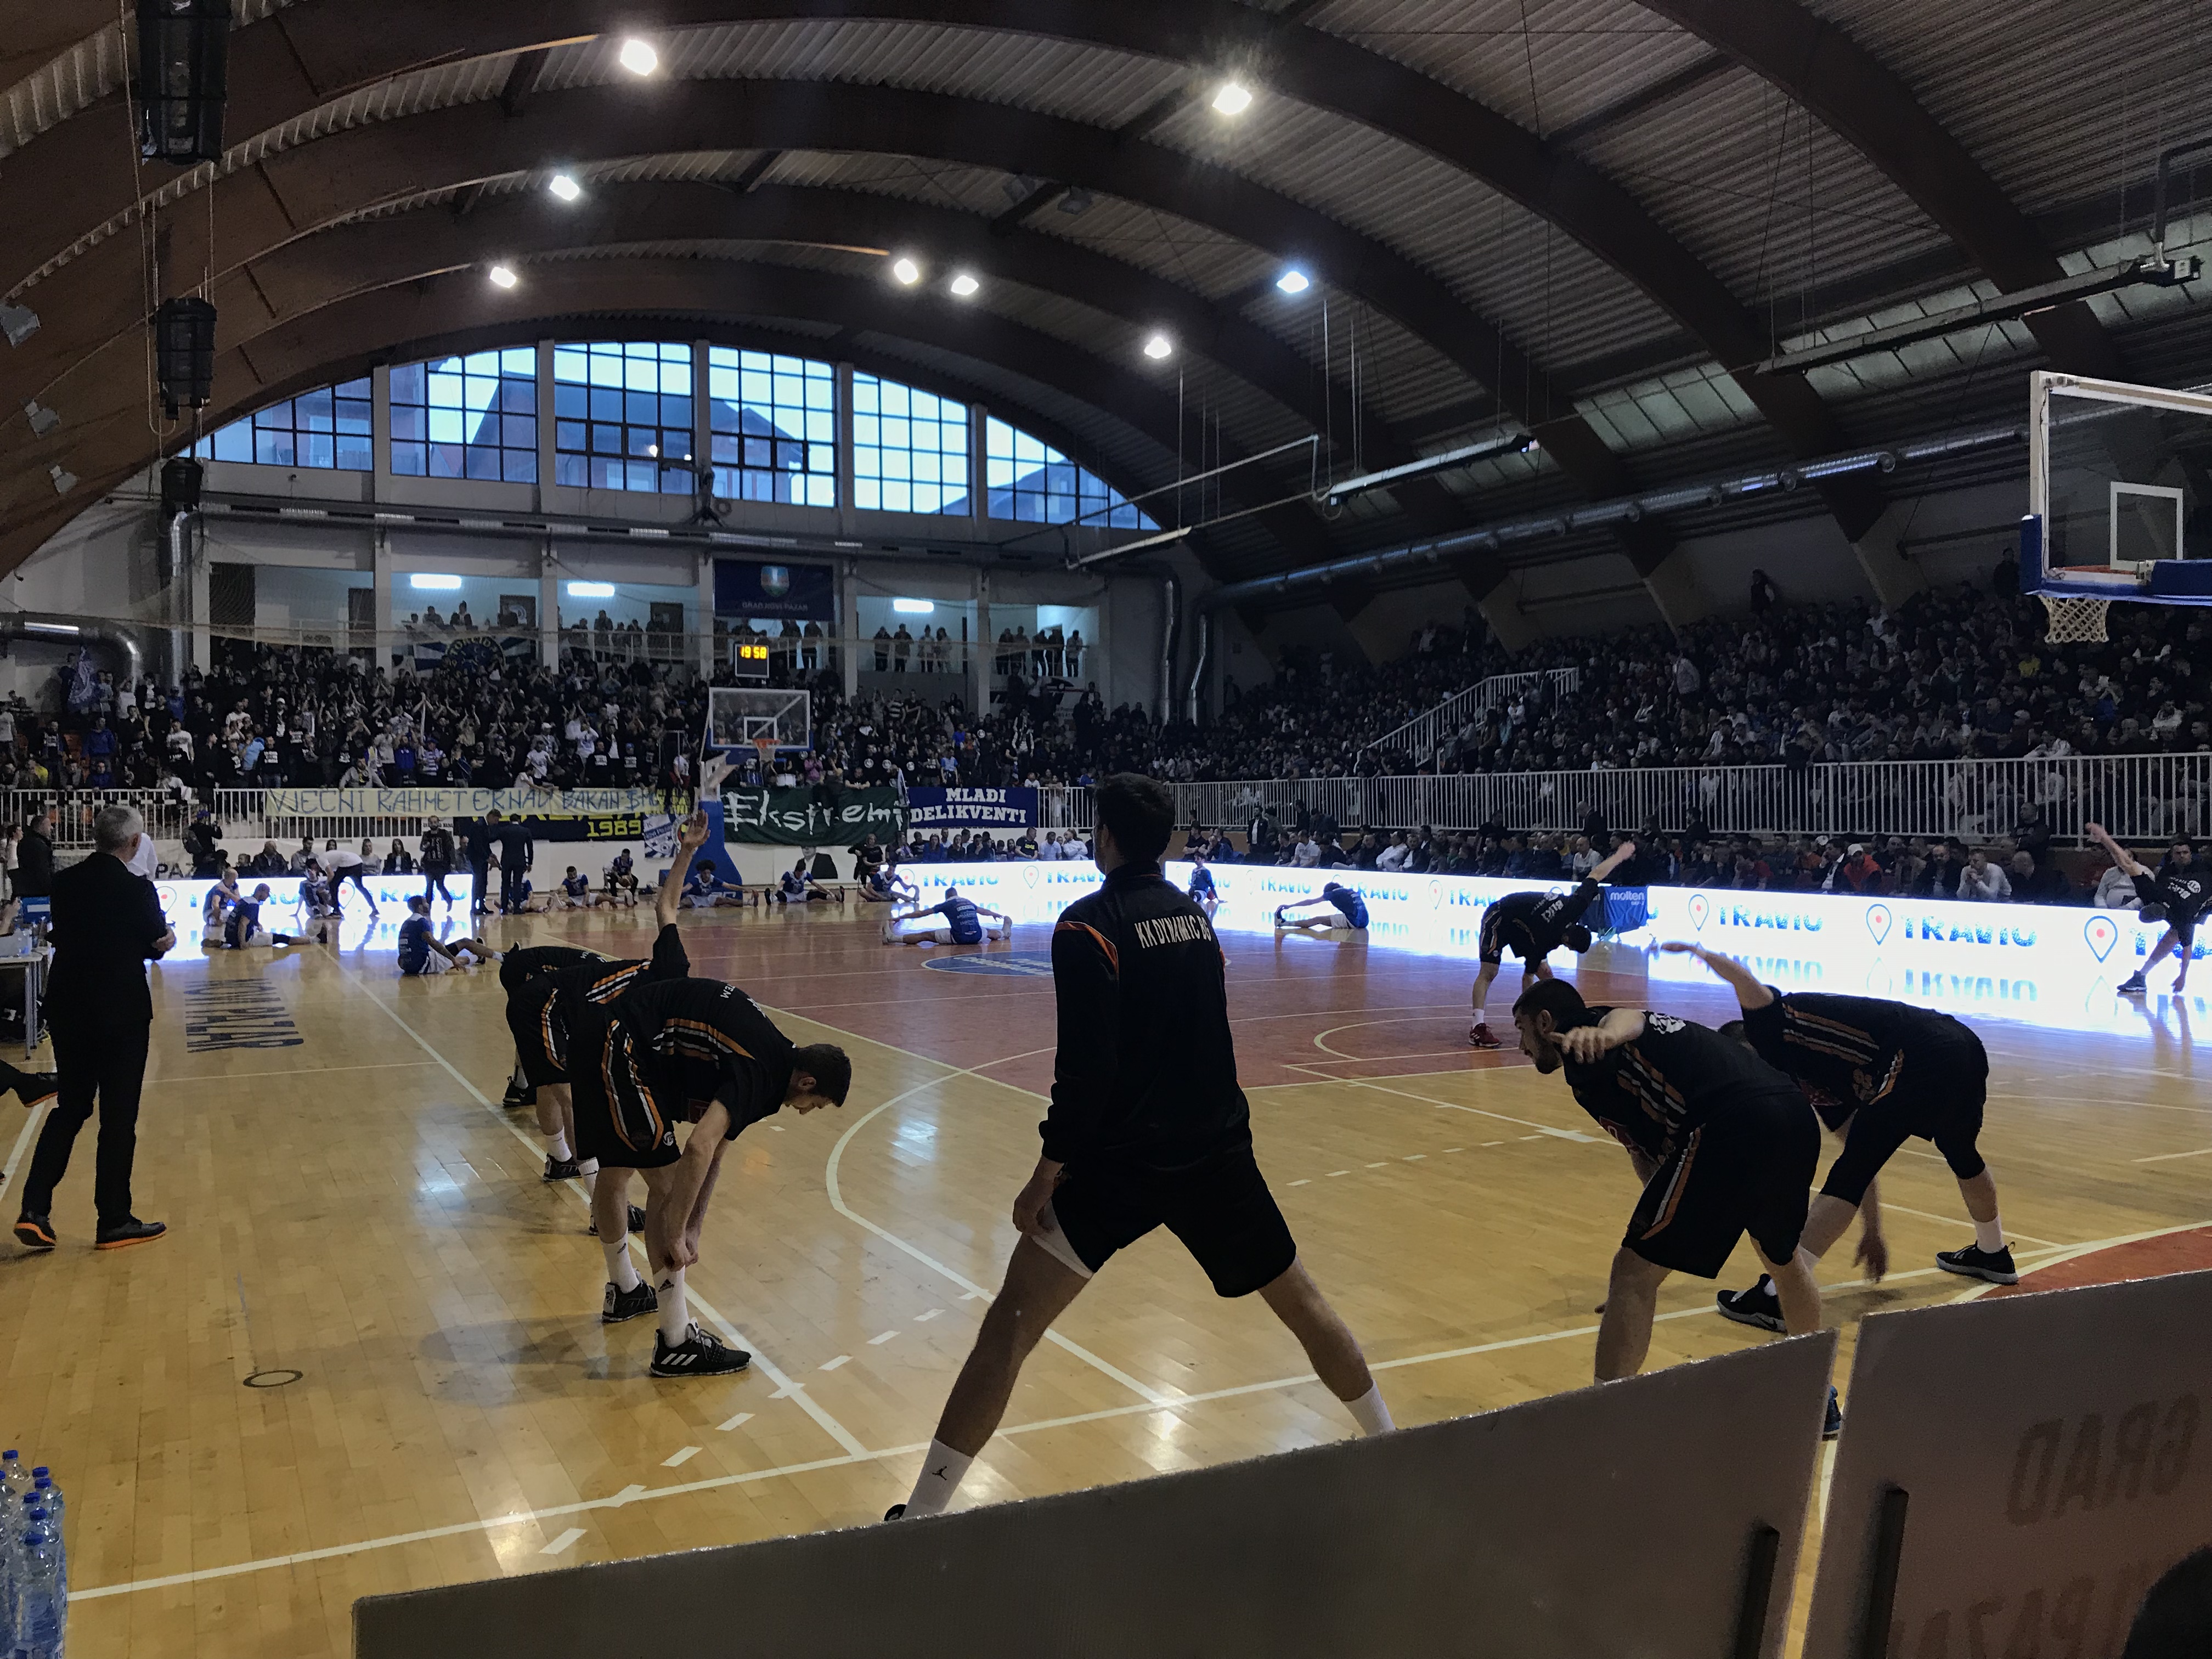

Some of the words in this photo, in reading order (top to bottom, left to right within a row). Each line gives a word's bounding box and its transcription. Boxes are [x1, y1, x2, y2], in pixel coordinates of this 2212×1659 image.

[910, 804, 1026, 823] DELIKVENTI
[586, 820, 641, 838] 1989
[1610, 890, 1645, 901] molten
[1134, 920, 1158, 949] KK
[1152, 915, 1200, 944] DYNAMIC
[1196, 915, 1212, 942] BG
